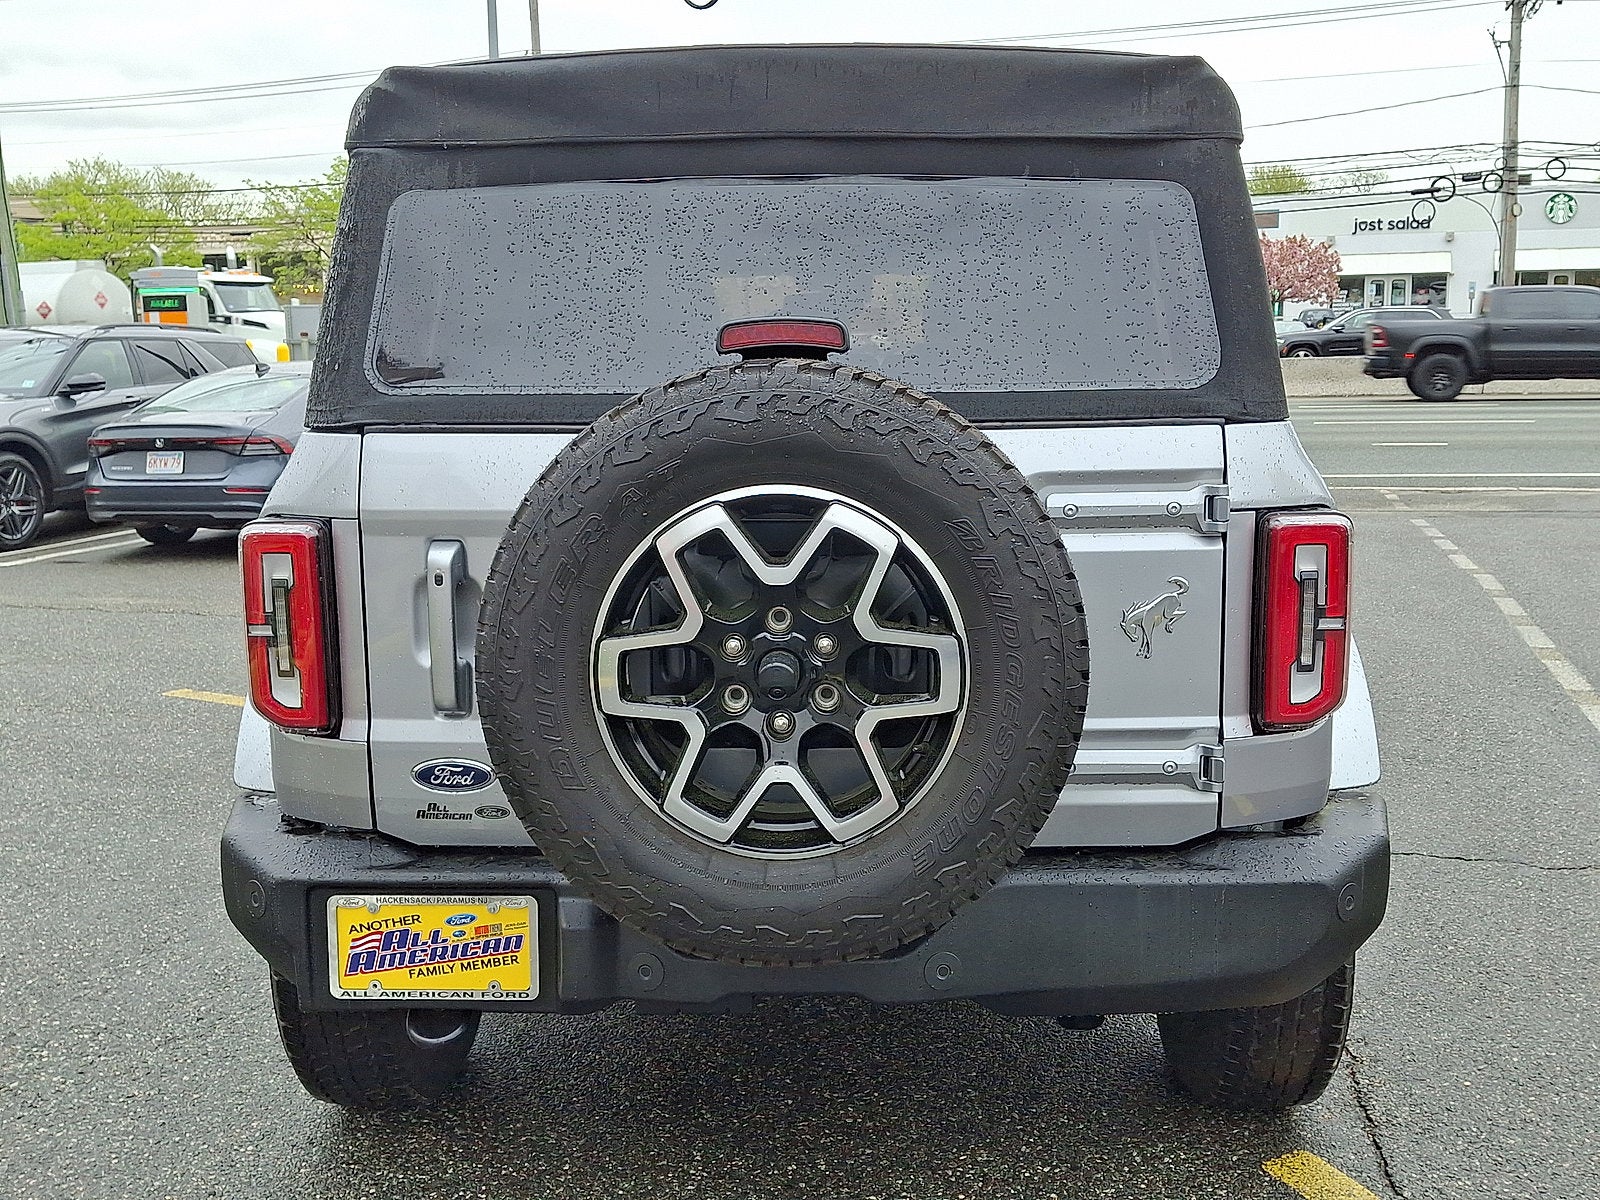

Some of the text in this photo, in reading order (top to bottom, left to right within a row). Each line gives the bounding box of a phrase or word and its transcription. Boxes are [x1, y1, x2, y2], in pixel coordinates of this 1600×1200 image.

[1352, 215, 1431, 235] just salad
[912, 517, 1026, 878] BRIDGESTONE
[430, 765, 475, 785] Ford
[416, 809, 473, 820] AMERICAN
[348, 914, 423, 935] ANOTHER
[449, 914, 473, 926] Ford
[345, 934, 525, 976] AMERICAN
[408, 955, 520, 979] FAMILY MEMBER
[340, 990, 531, 999] ALL AMERICAN FORD
